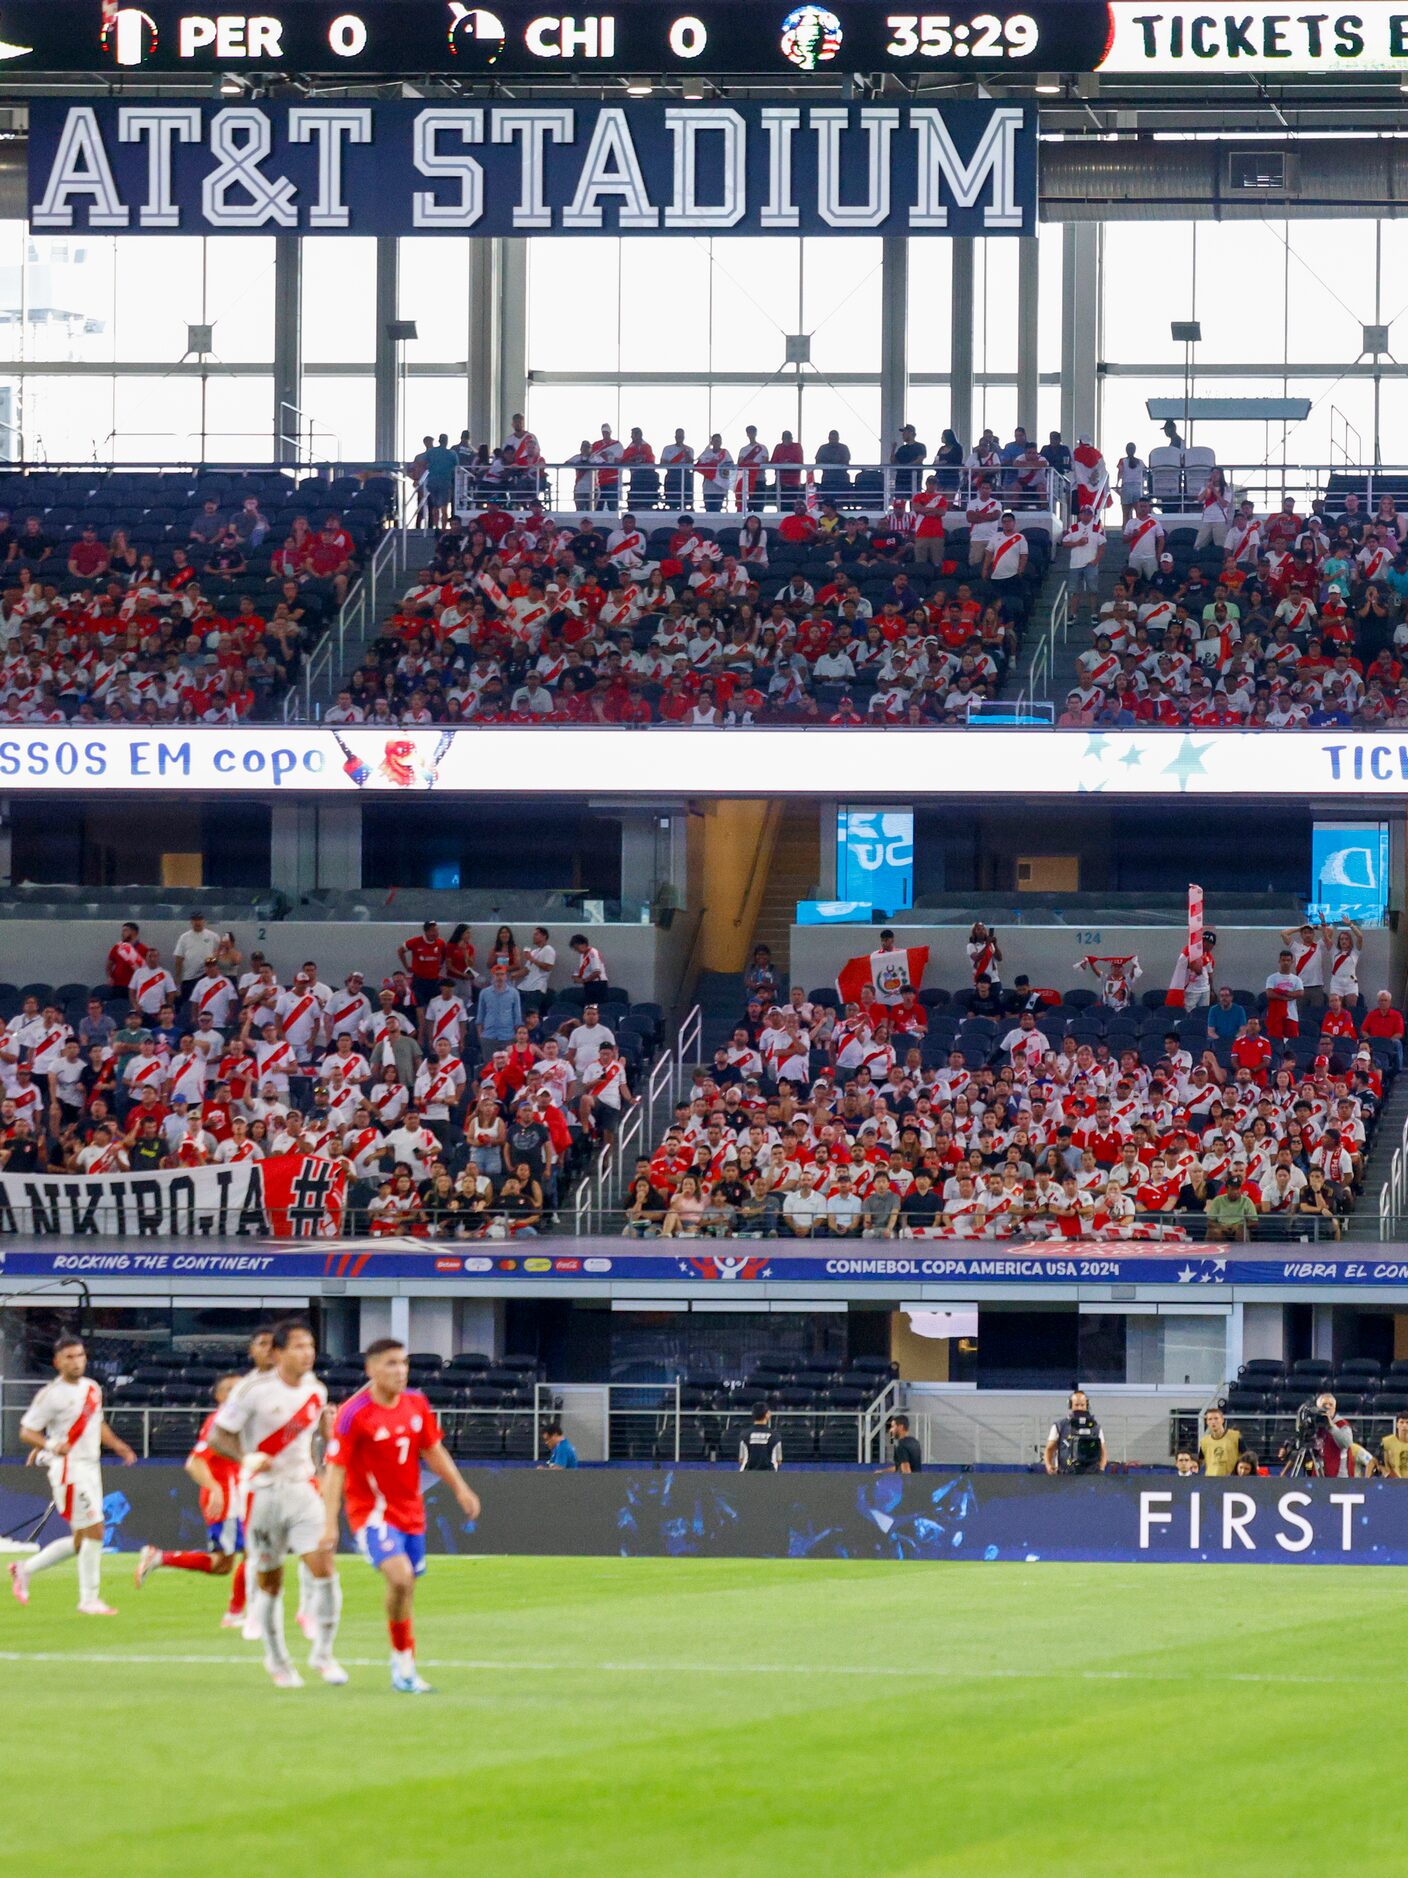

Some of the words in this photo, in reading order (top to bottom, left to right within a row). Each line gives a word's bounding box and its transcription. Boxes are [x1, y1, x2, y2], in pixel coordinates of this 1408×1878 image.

[180, 16, 284, 58] PER
[328, 15, 367, 58] 0
[524, 16, 615, 58] CHI
[669, 16, 708, 59] 0
[886, 16, 1040, 58] 35:29
[1132, 14, 1364, 58] TICKETS
[32, 106, 372, 228] AT&T
[412, 106, 1024, 229] STADIUM
[0, 742, 107, 776] SSOS
[130, 743, 190, 776] EM
[1076, 932, 1102, 945] 124
[53, 1255, 131, 1269] ROCKING
[133, 1255, 168, 1269] THE
[172, 1256, 274, 1270] CONTINENT
[826, 1259, 919, 1275] CONMEBOL
[921, 1260, 966, 1275] COPA
[969, 1261, 1044, 1276] AMERICA
[1046, 1262, 1078, 1276] USA
[1080, 1262, 1120, 1277] 2024
[1283, 1263, 1337, 1277] VIBRA
[1345, 1264, 1368, 1278] EL
[395, 1436, 410, 1465] 7
[1139, 1490, 1366, 1552] FIRST
